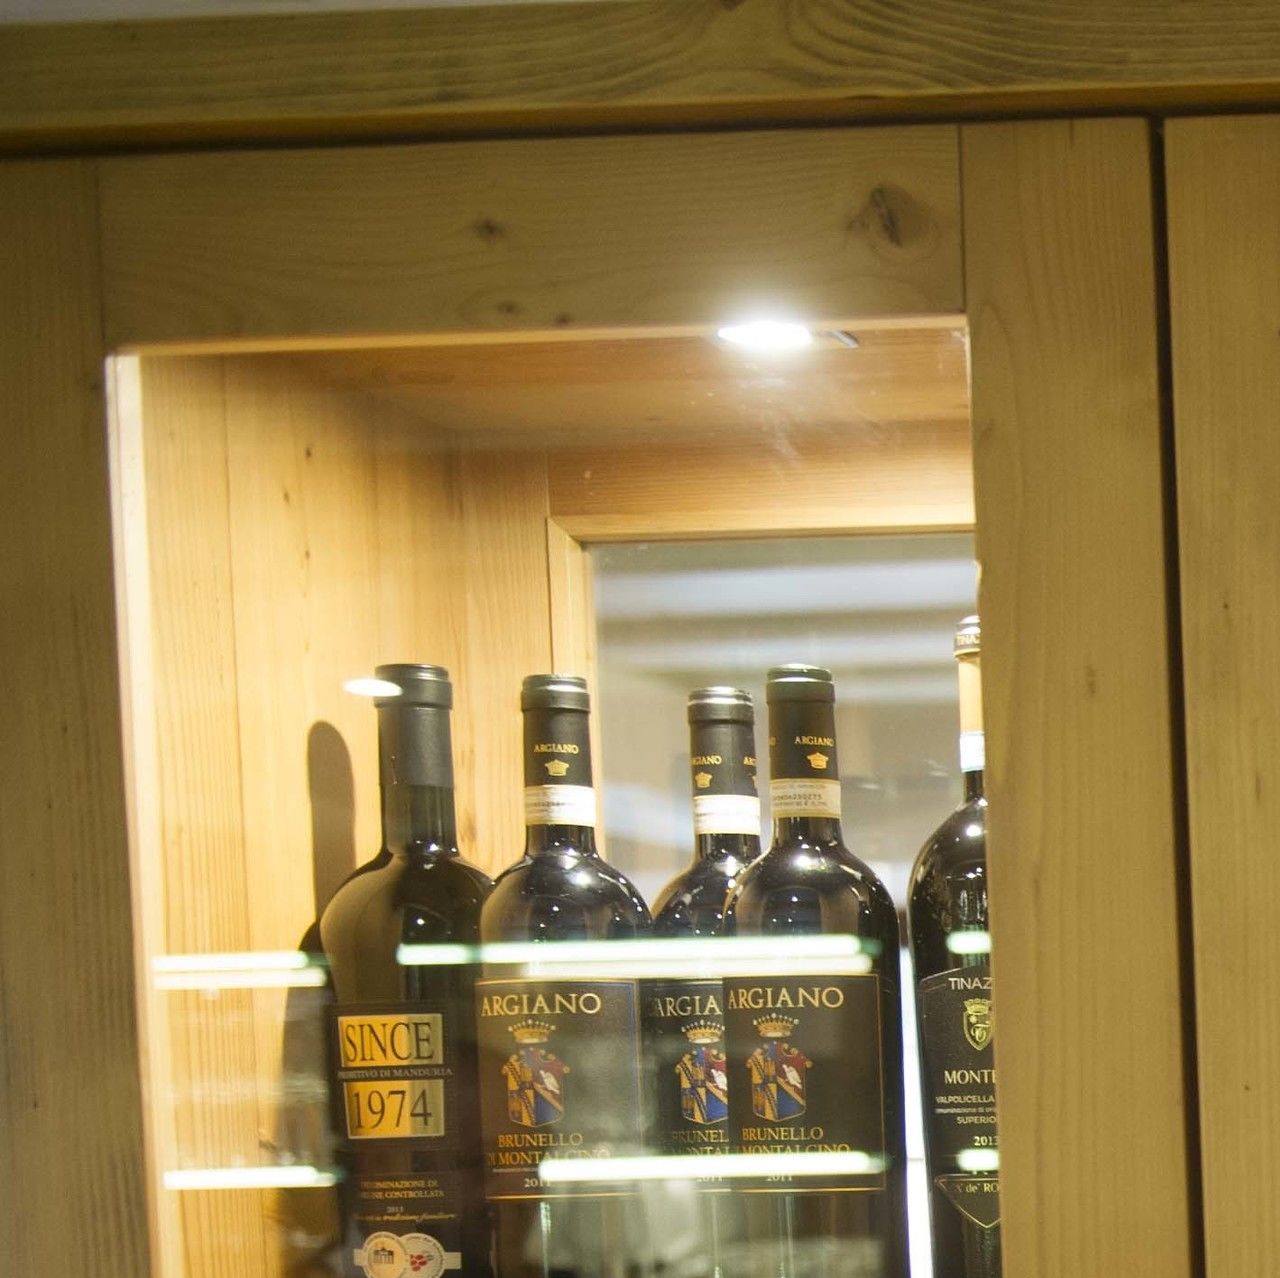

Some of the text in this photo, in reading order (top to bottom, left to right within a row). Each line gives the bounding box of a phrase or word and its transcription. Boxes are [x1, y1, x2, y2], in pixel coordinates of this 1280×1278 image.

[533, 743, 579, 755] ARGIANO
[795, 735, 834, 747] ARGIANO
[481, 993, 602, 1017] ARGIANO
[729, 987, 844, 1009] ARGIANO
[344, 1022, 434, 1063] SINCE
[393, 1067, 453, 1078] MANDURIA
[353, 1088, 433, 1130] 1974
[498, 1132, 584, 1148] BRUNELLO
[742, 1126, 824, 1141] BRUNELLO
